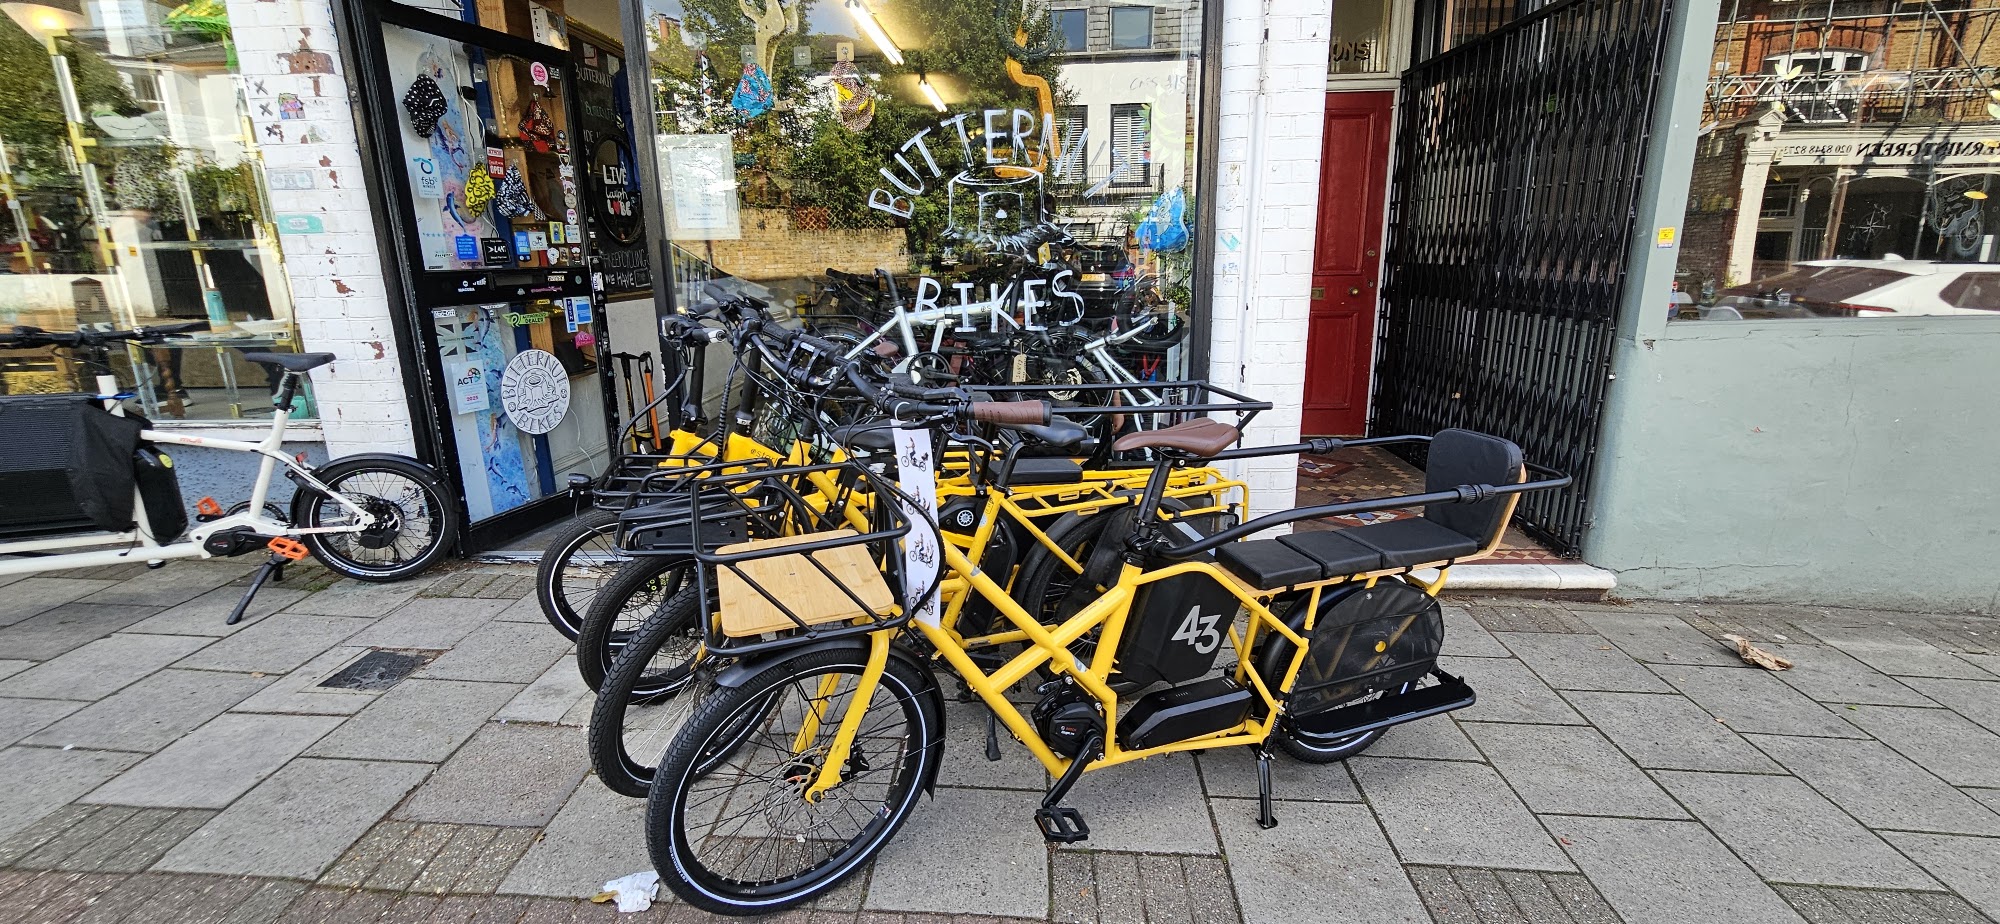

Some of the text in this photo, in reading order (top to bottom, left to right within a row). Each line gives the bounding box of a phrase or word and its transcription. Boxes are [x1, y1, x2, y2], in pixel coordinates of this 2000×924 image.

[603, 165, 628, 186] LIVE
[616, 271, 635, 288] HAVE
[914, 269, 1084, 334] BIKES
[457, 377, 473, 386] ACT
[502, 351, 568, 400] BUTTERNUT
[517, 405, 563, 433] BIKES
[1171, 604, 1222, 655] 43
